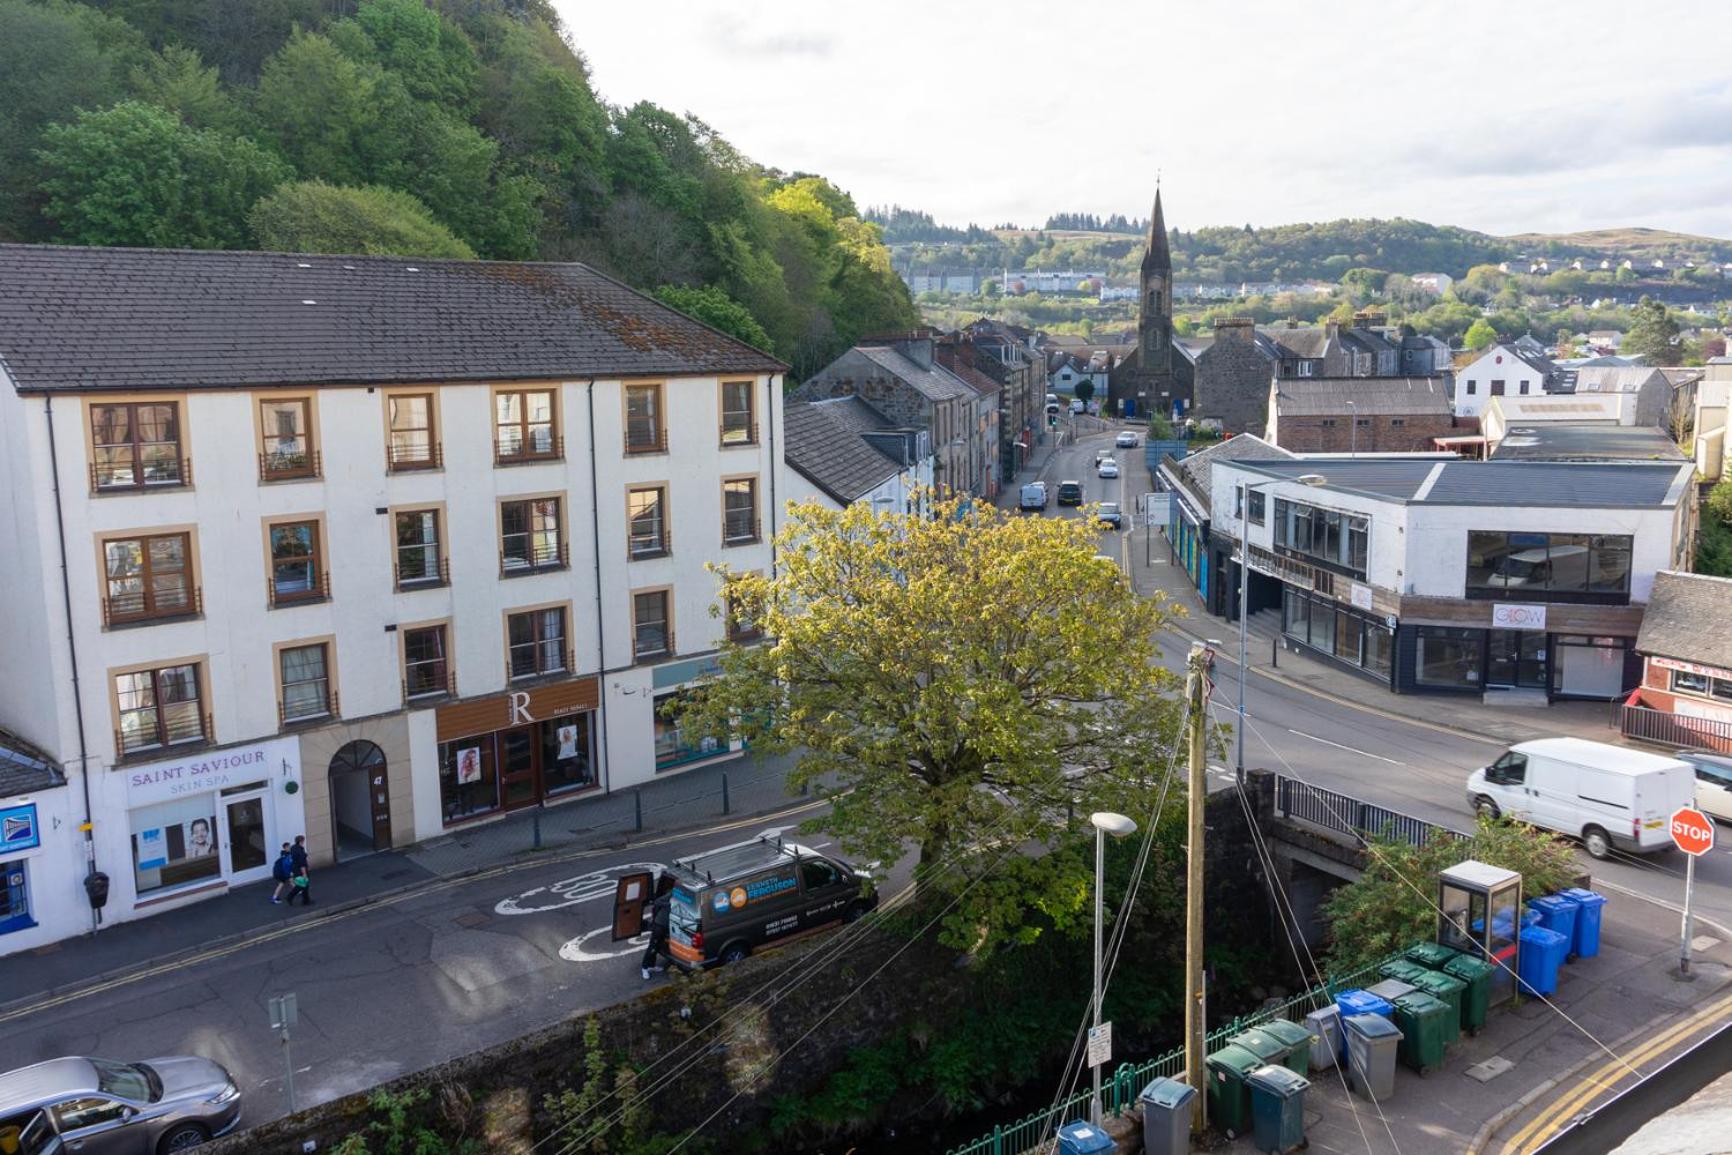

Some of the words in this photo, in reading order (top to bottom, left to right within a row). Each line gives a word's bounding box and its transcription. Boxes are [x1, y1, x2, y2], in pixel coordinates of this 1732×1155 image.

[511, 691, 536, 726] R
[132, 766, 184, 787] SAINT
[190, 751, 265, 775] SAVIOUR
[171, 780, 201, 795] SKIN
[207, 775, 230, 787] SPA
[1672, 820, 1711, 842] STOP
[747, 878, 797, 899] FERGUSON
